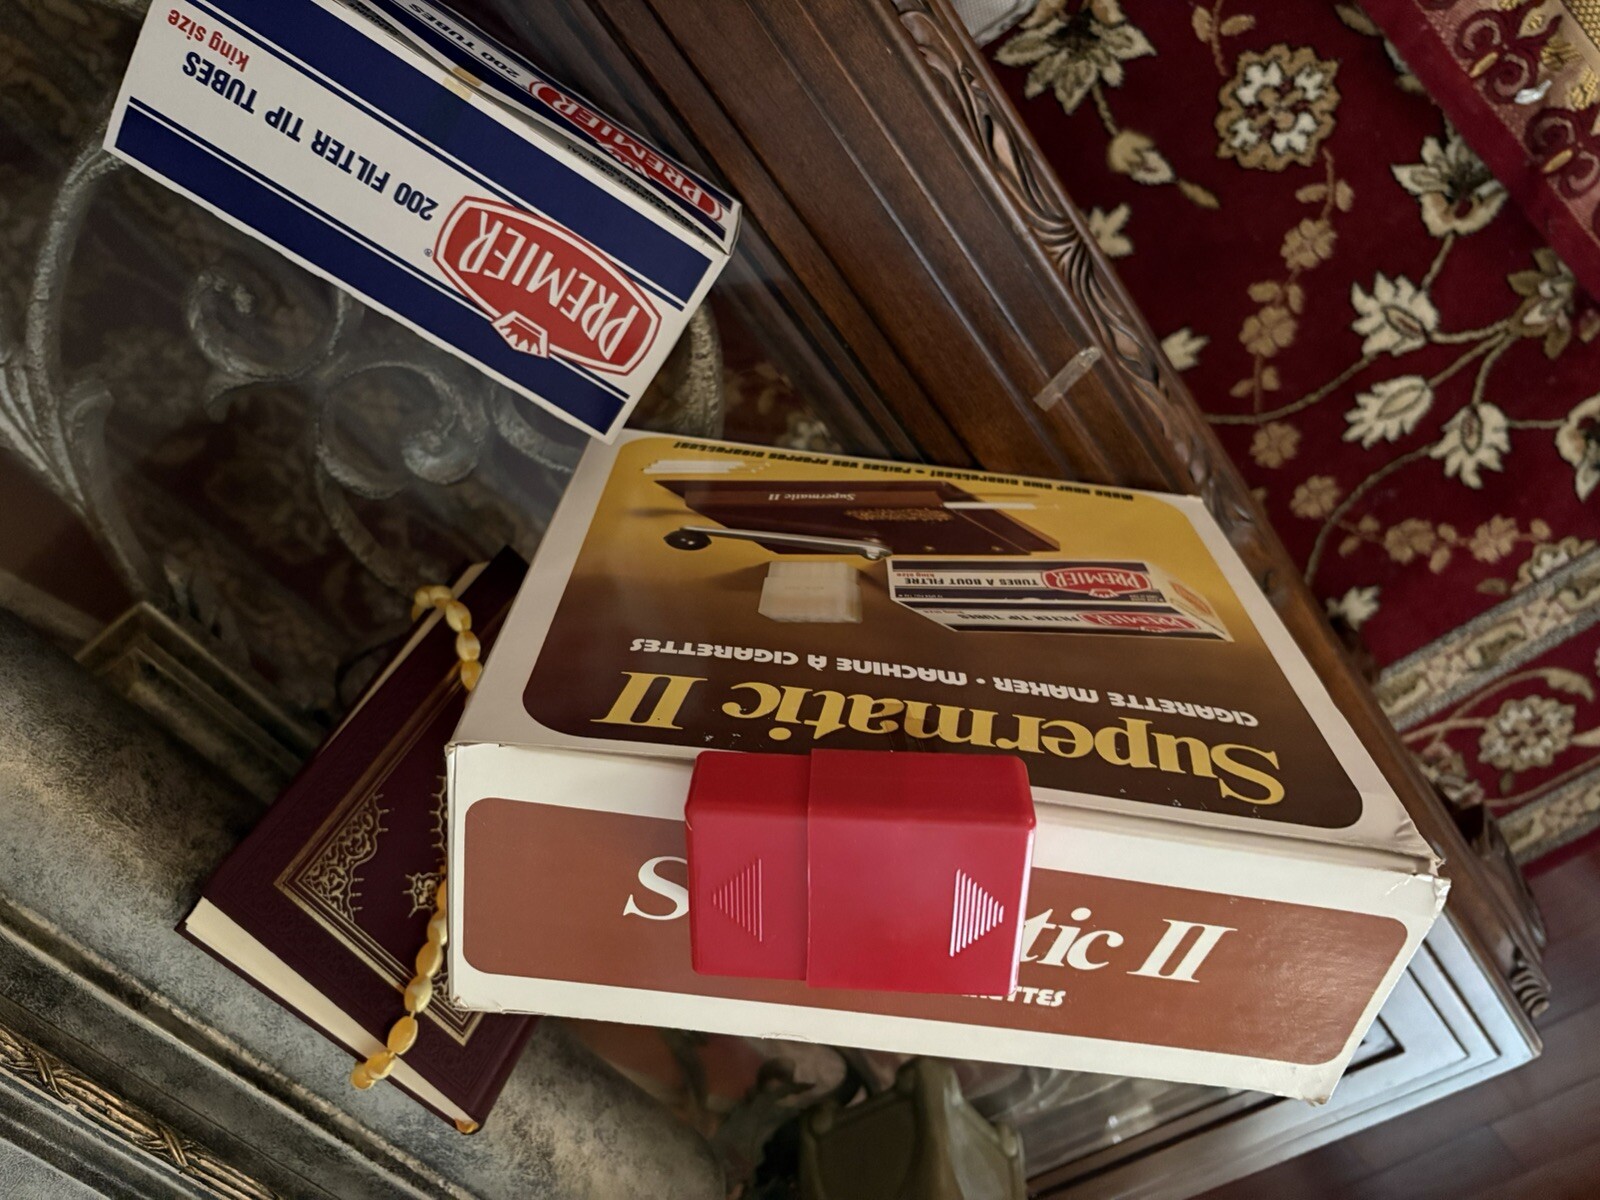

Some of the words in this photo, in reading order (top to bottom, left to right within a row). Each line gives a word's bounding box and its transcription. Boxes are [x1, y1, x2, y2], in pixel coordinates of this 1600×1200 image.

[167, 9, 207, 42] size
[409, 3, 476, 50] TUBES
[208, 30, 250, 72] king
[480, 51, 521, 79] 200
[182, 51, 257, 114] TUBES
[264, 106, 304, 142] TIP
[310, 129, 391, 194] FILTER
[552, 91, 703, 204] PREMIER
[567, 144, 615, 177] ORIGINAL
[393, 182, 439, 221] 200
[458, 211, 639, 360] PREMIER
[768, 492, 781, 501] II
[784, 492, 856, 501] Supermatic
[904, 577, 944, 585] FILTRE
[948, 577, 982, 585] BOUT
[999, 578, 1039, 586] TUBES
[1051, 571, 1140, 588] PREMIER
[1096, 613, 1187, 628] PREMIER
[629, 638, 799, 665] CIGARETTES
[807, 653, 828, 671] À
[836, 657, 968, 686] MACHINE
[590, 671, 708, 729] II
[992, 676, 1100, 703] MAKER
[1107, 691, 1259, 727] CIGARETTE
[722, 681, 1285, 805] Supermatic
[1126, 918, 1238, 983] II
